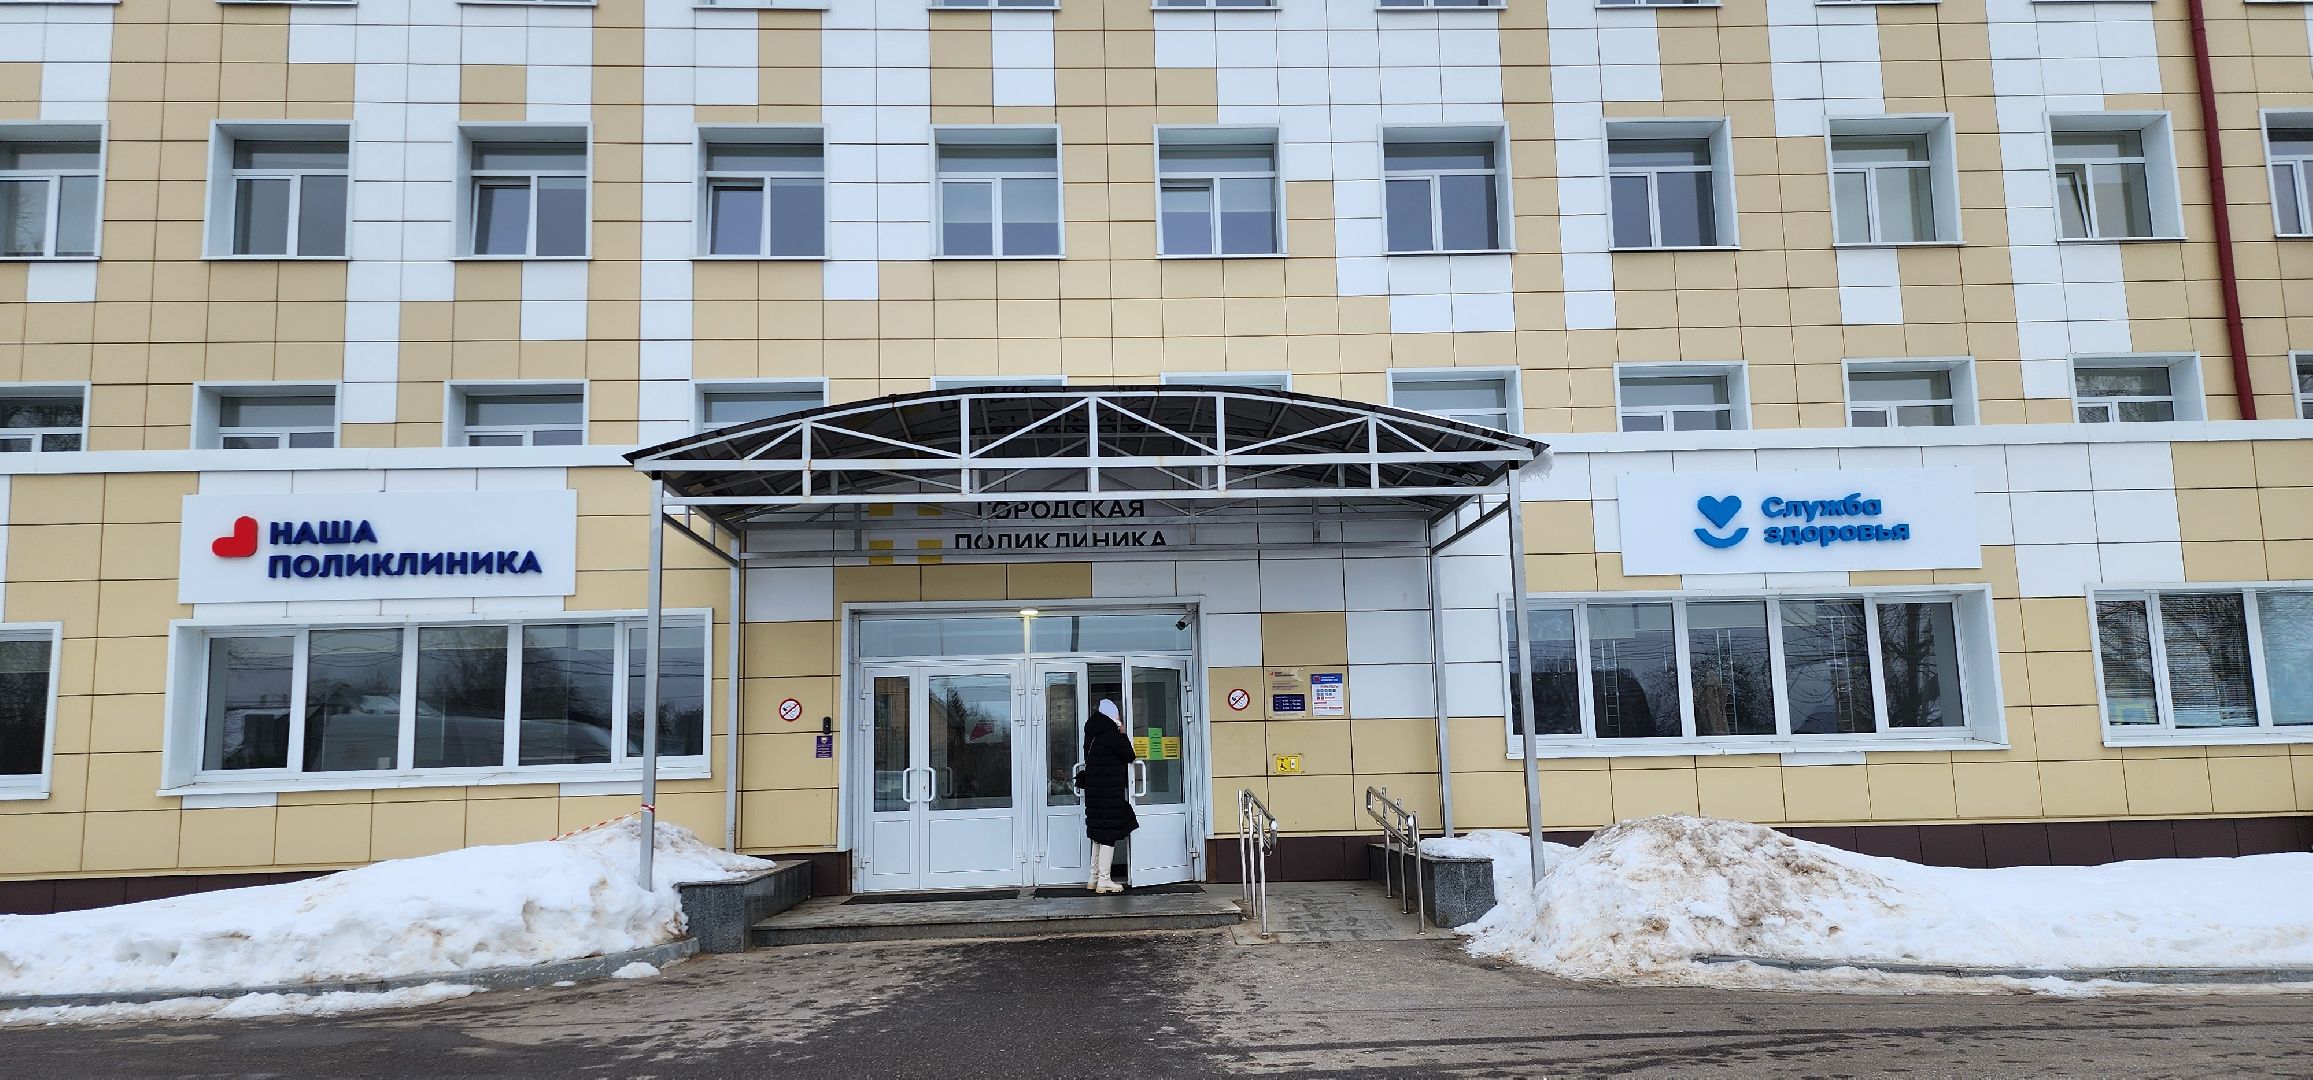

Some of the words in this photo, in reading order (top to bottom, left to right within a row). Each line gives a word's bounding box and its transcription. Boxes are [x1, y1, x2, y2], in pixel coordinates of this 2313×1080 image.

[1761, 492, 1882, 523] Служба
[269, 520, 378, 545] НАША
[954, 530, 1167, 549] ПОЛИКЛИНИКА
[1763, 523, 1910, 548] здоровья
[268, 550, 543, 579] ПОЛИКЛИНИКА
